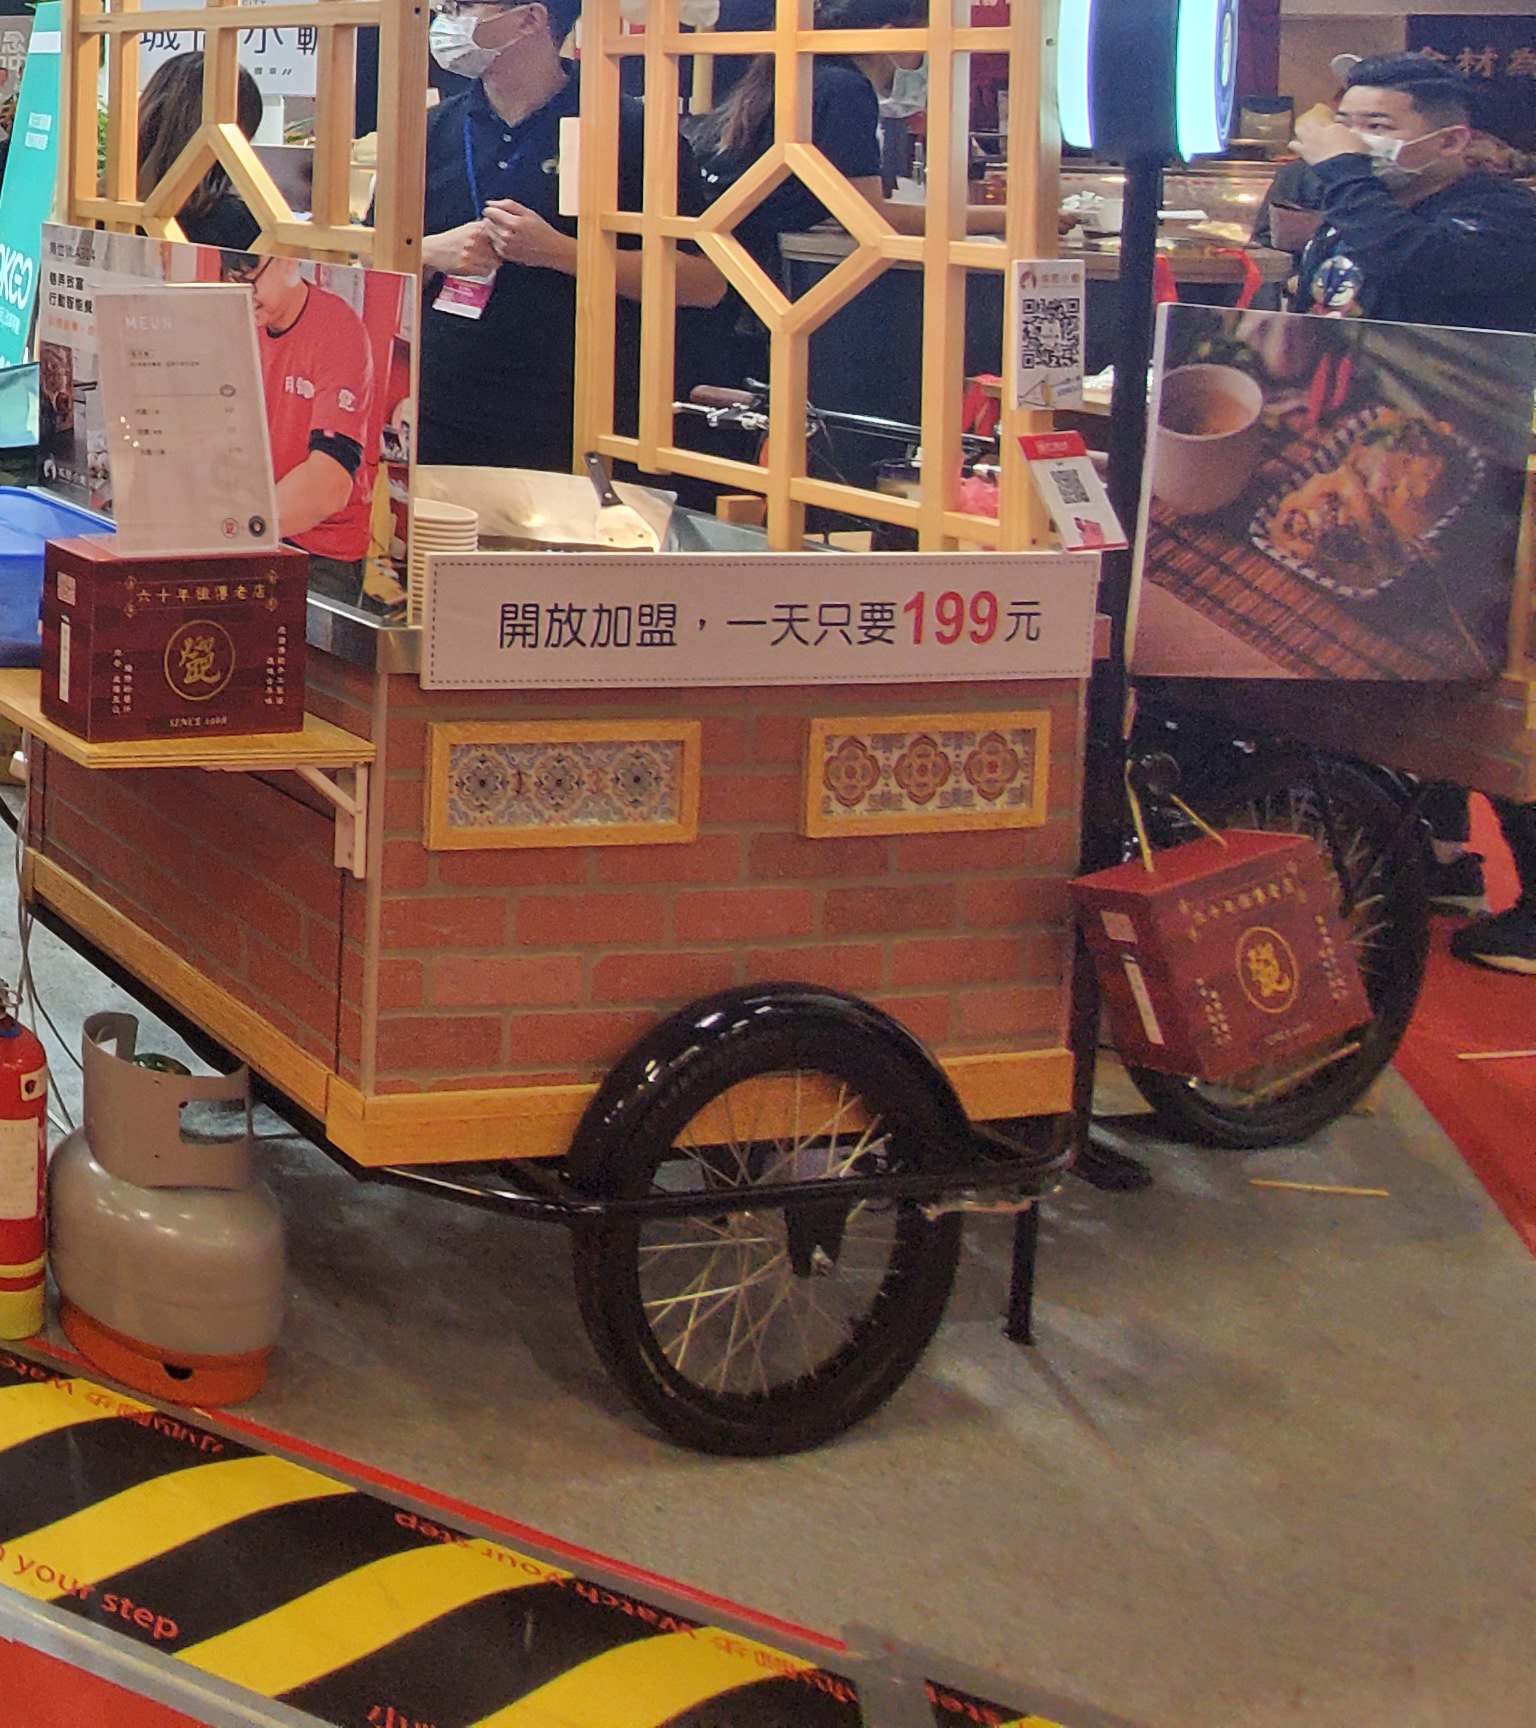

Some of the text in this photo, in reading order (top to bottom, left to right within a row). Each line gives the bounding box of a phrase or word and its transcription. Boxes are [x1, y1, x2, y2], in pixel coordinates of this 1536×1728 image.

[498, 588, 1042, 651] 開放加盟，一天只要199元
[15, 1552, 96, 1604] your
[100, 1587, 181, 1643] step
[392, 1510, 472, 1548] step
[573, 1578, 698, 1641] Watch
